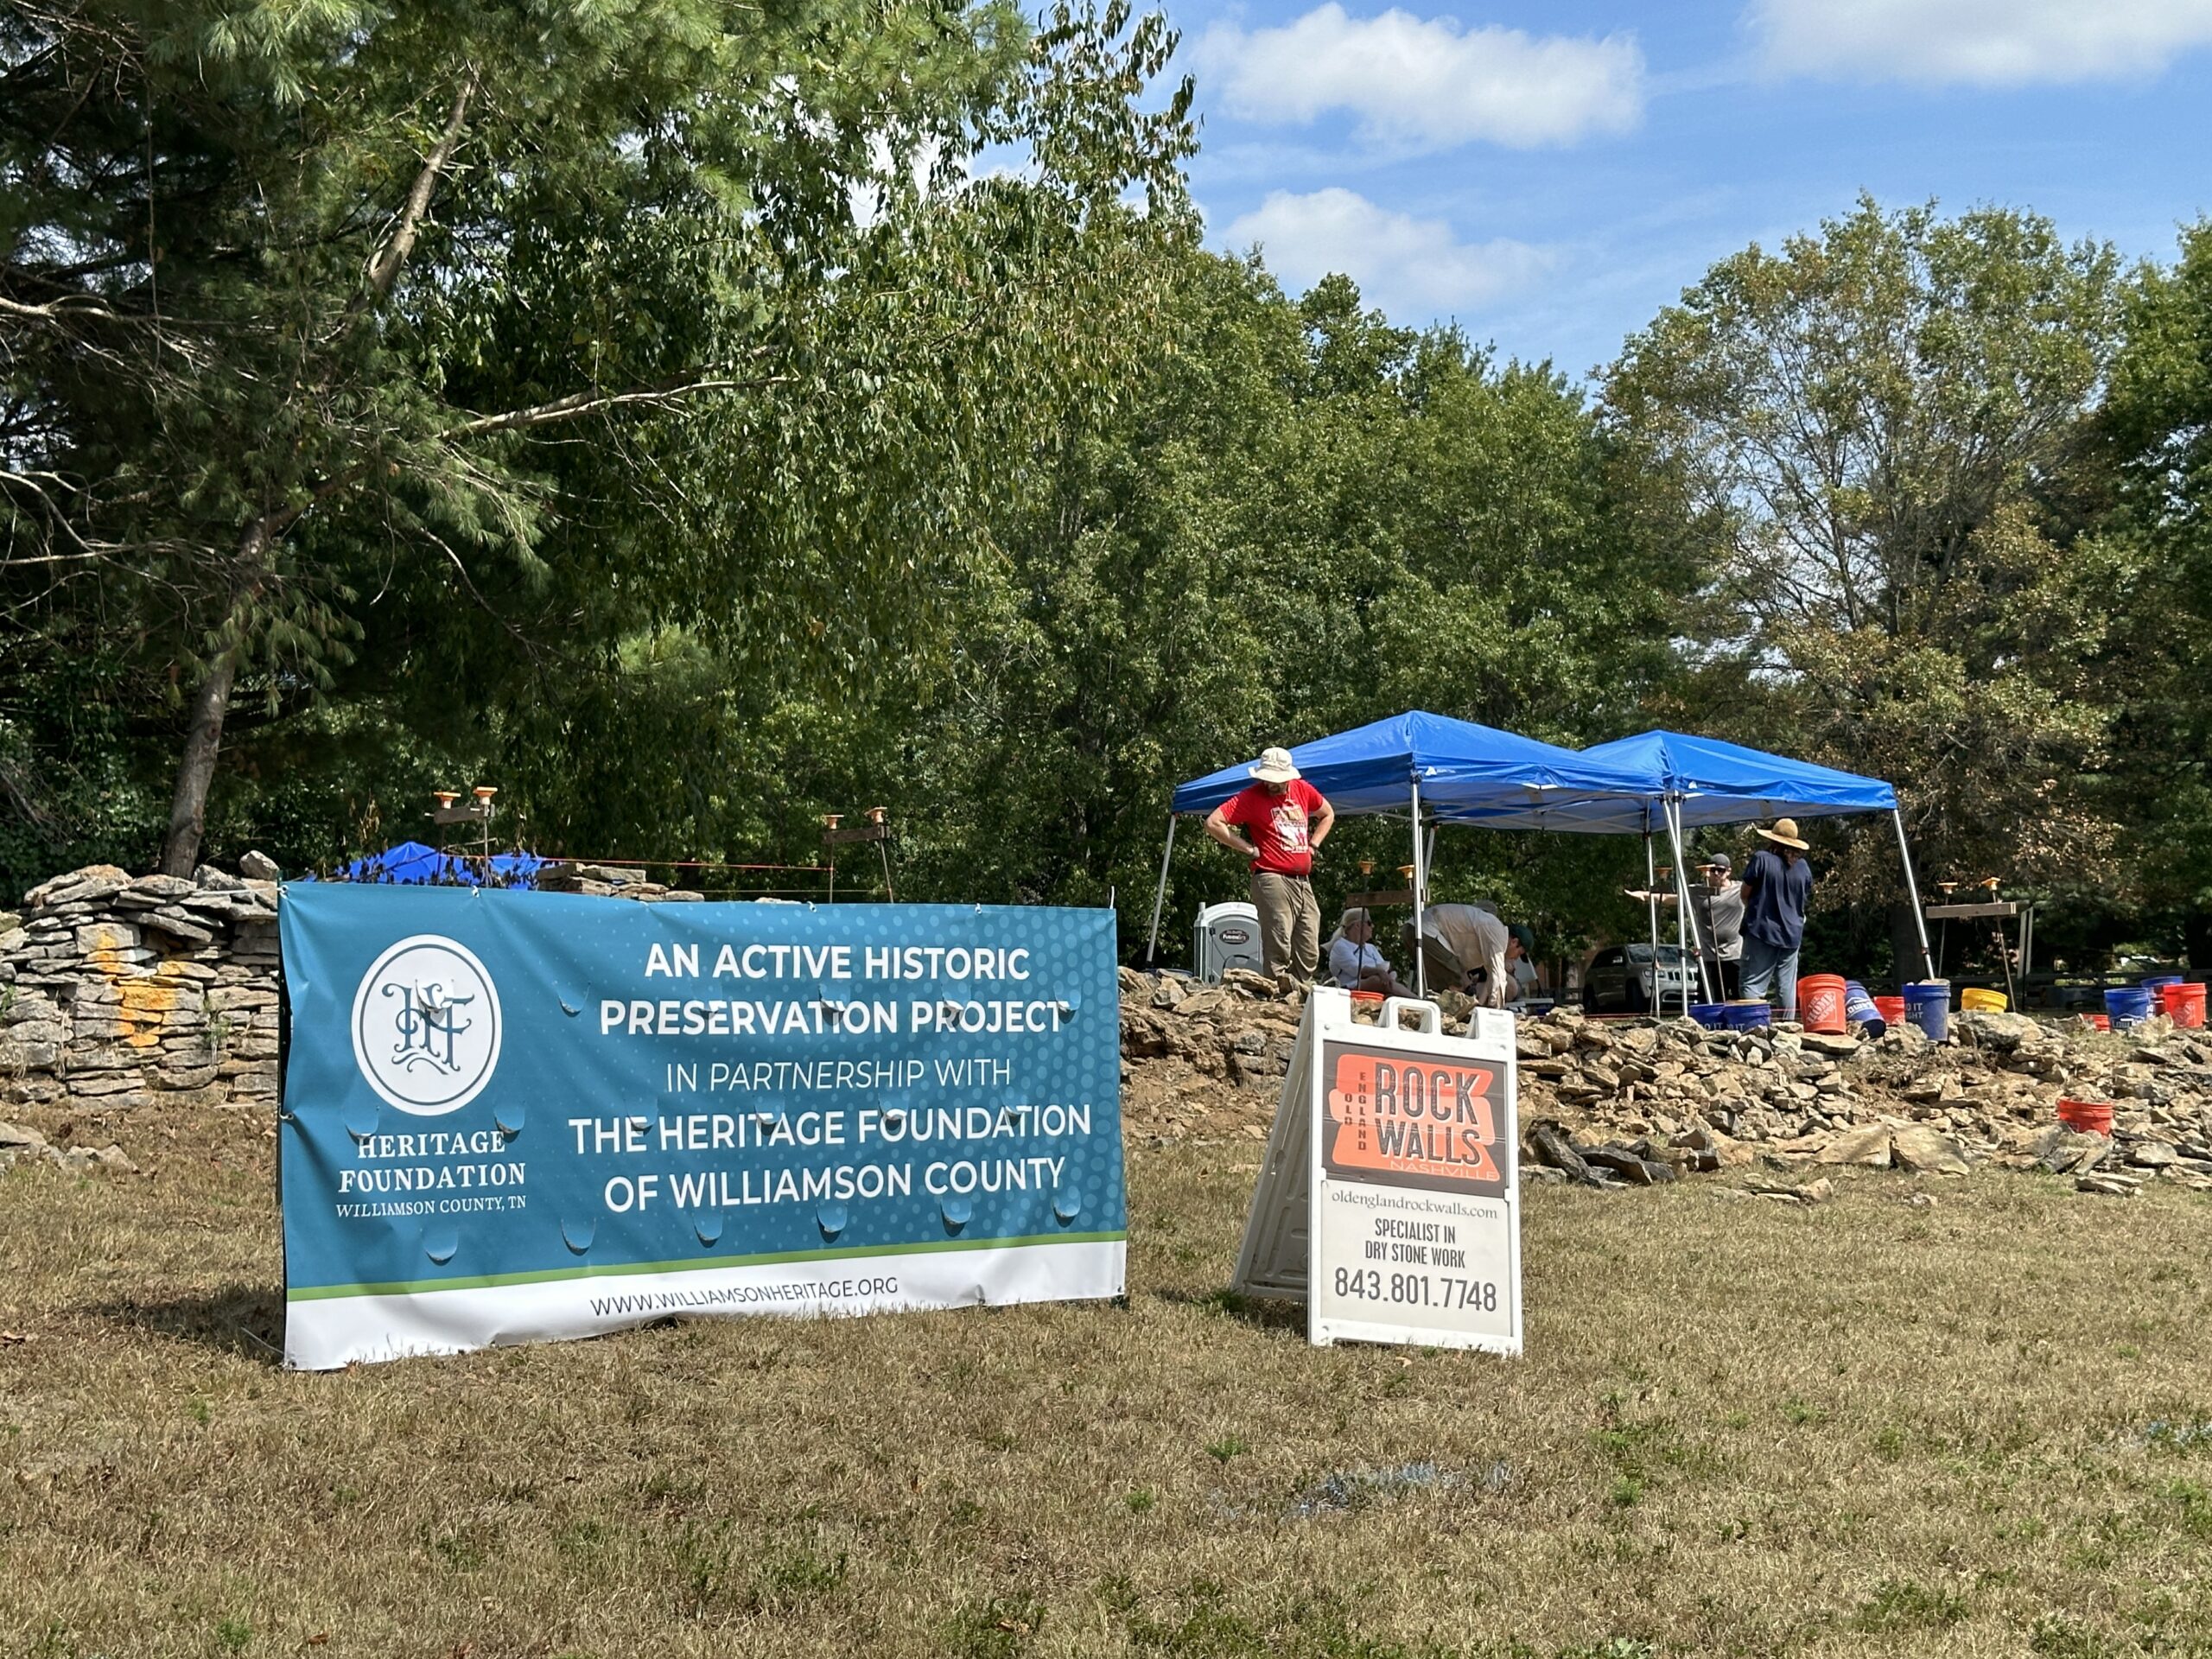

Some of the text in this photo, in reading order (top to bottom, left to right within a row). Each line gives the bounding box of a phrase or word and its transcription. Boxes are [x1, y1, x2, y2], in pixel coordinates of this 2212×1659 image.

[645, 943, 1030, 981] AN ACTIVE HISTORIC
[601, 1000, 1071, 1035] PRESERVATION PROJECT
[1806, 991, 1835, 1024] HOME
[1913, 1002, 1924, 1012] IT
[667, 1058, 1010, 1092] IN PARTNERSHIP WITH
[1344, 1092, 1353, 1126] OLD
[1357, 1071, 1367, 1151] ENGLAND
[1375, 1062, 1481, 1128] ROCK
[358, 1130, 506, 1160] HERITAGE
[568, 1103, 1091, 1154] THE HERITAGE FOUNDATION
[1375, 1118, 1482, 1166] WALLS
[338, 1162, 526, 1194] FOUNDATION
[605, 1155, 1065, 1213] OF WILLIAMSON COUNTY
[1390, 1160, 1497, 1181] NASHVILLE
[336, 1195, 527, 1218] WILLIAMSON COUNTY, TN
[1332, 1190, 1498, 1220] oldenglandrockwalls.com
[1375, 1217, 1456, 1244] SPECIALIST IN
[1364, 1240, 1466, 1268] DRY STONE WORK
[590, 1276, 899, 1318] WWW.WILLIAMSONHERITAGE.ORG
[1335, 1267, 1497, 1312] 843.801.7748
